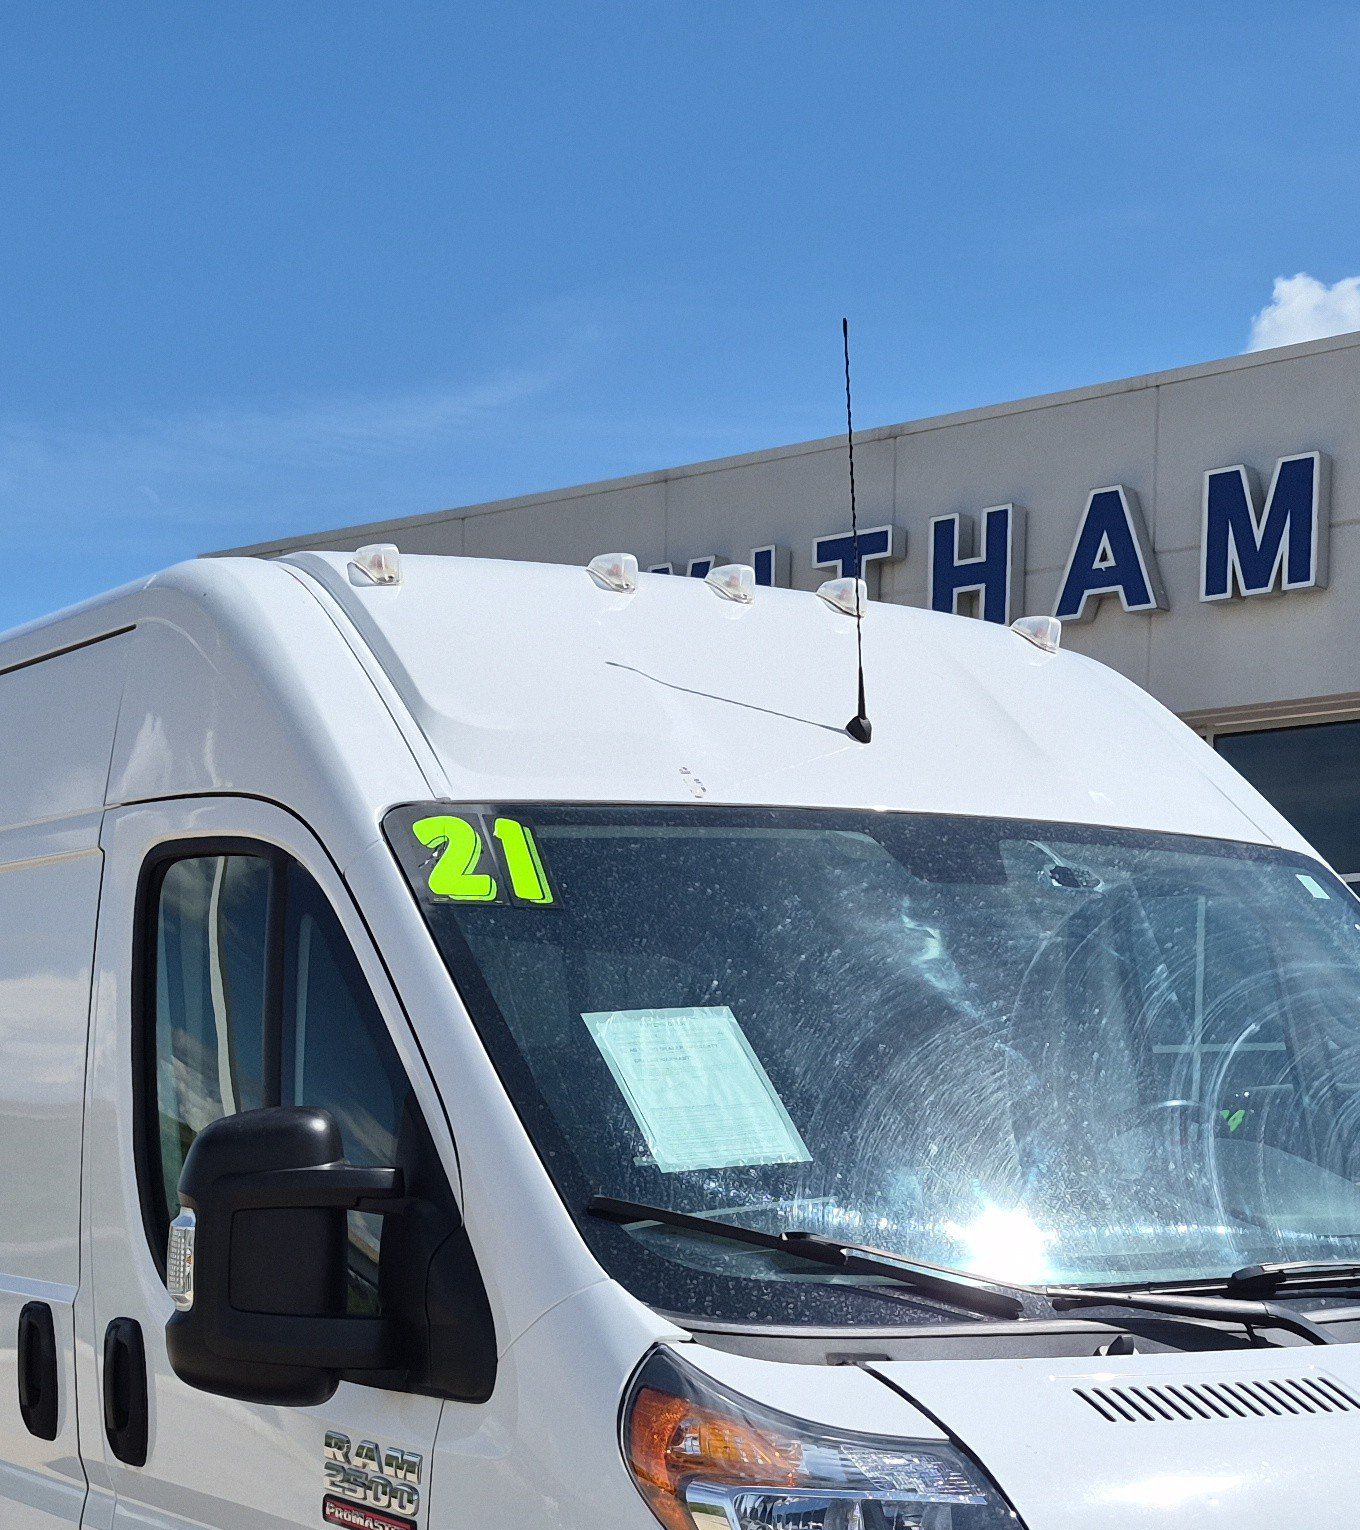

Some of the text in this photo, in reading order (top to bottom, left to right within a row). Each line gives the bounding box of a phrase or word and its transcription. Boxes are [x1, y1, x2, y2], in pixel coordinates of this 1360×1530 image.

[646, 450, 1328, 626] THAM
[412, 815, 554, 904] 21
[324, 1429, 424, 1486] RAM
[324, 1461, 420, 1518] 2500
